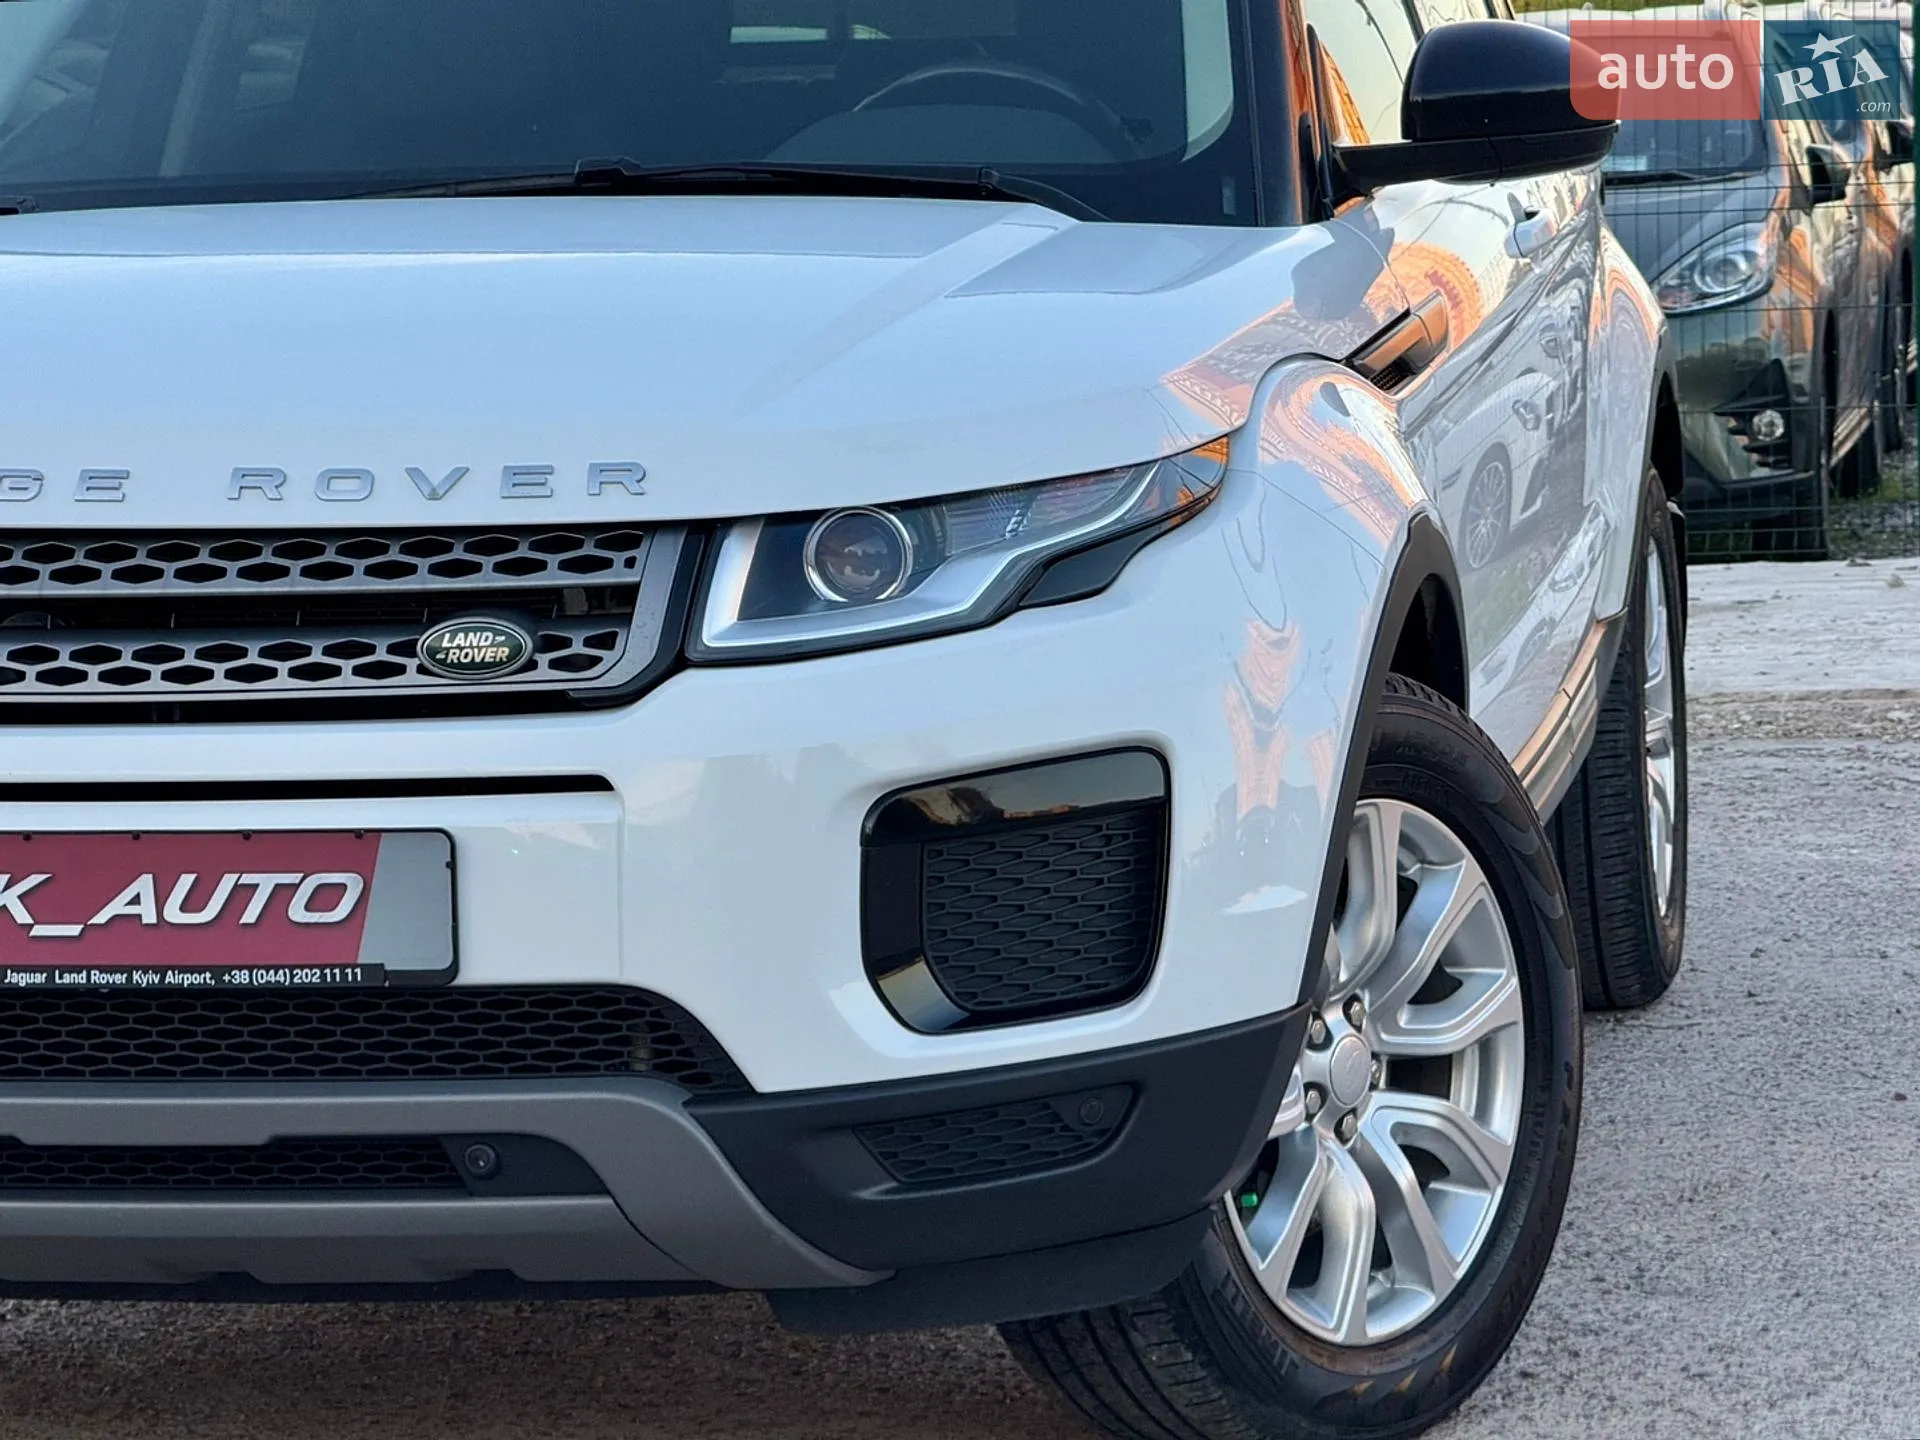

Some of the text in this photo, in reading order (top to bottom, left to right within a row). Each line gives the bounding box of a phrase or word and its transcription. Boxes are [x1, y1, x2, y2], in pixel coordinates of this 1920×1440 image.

[226, 461, 647, 501] ROVER
[441, 631, 494, 648] LAND
[446, 647, 510, 664] ROVER
[4, 967, 362, 987] Jaguar Land Rover Kyiv Airport, +38 (044) 202 11 11
